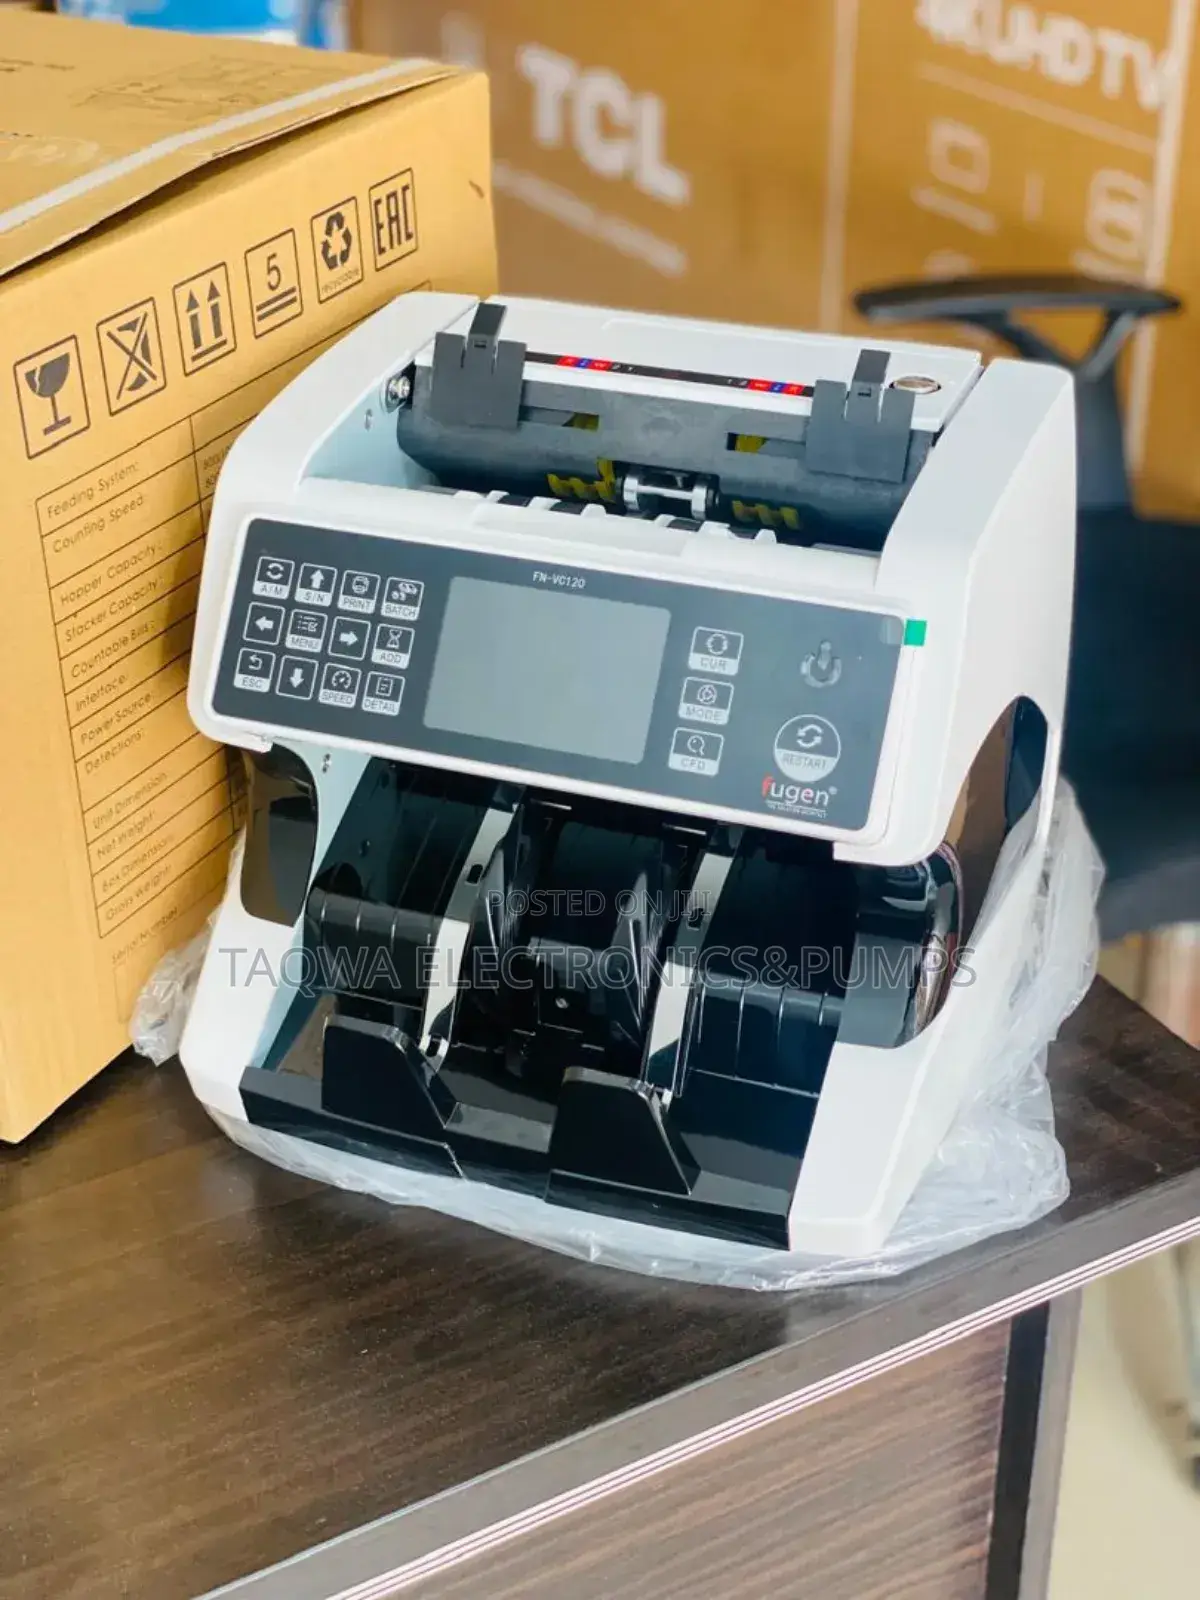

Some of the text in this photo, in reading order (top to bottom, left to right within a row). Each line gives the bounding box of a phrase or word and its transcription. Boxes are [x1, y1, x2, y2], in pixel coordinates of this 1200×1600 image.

[515, 43, 692, 208] TCL
[266, 252, 282, 291] 5
[47, 487, 94, 518] Feeding
[53, 518, 105, 553] Counting
[532, 571, 586, 589] FN-VC120
[343, 596, 371, 610] PRINT
[384, 605, 416, 617] BATCH
[291, 636, 320, 649] MENU
[379, 653, 401, 663] ADD
[242, 678, 263, 689] ESC
[321, 692, 353, 705] SPEED
[364, 699, 397, 713] DETAIL
[686, 706, 722, 721] MODE
[783, 753, 828, 770] RESTART
